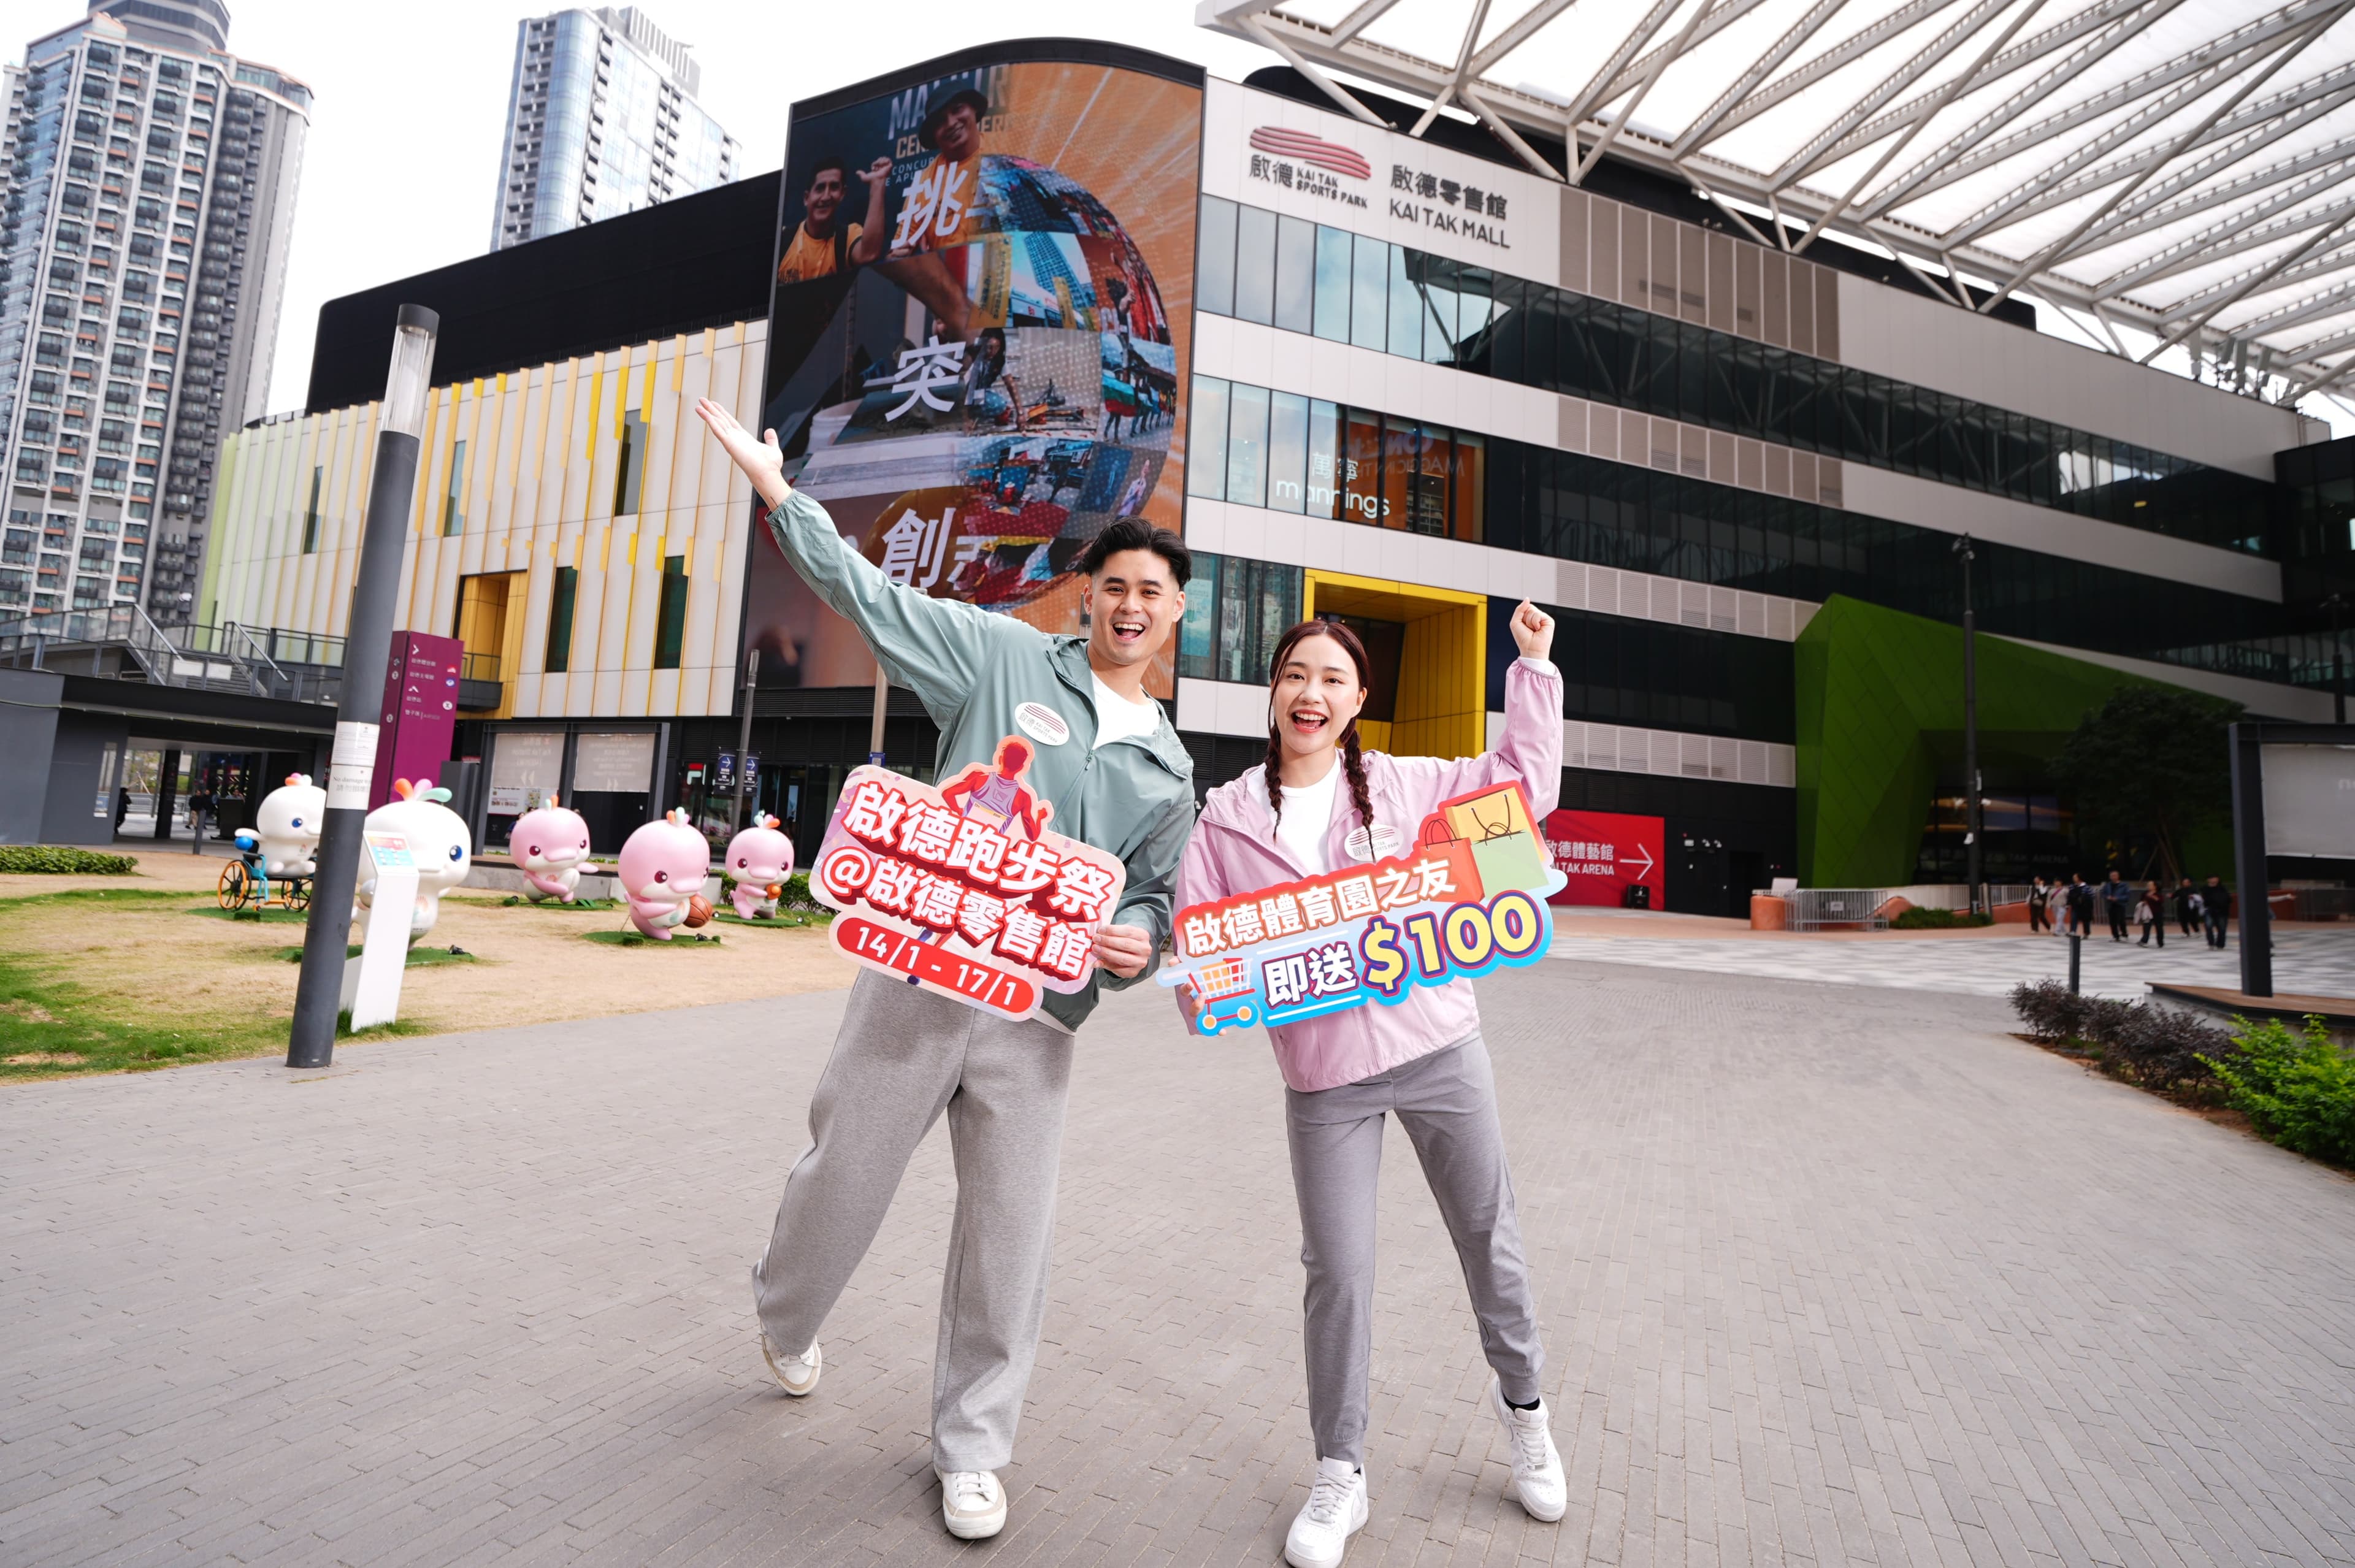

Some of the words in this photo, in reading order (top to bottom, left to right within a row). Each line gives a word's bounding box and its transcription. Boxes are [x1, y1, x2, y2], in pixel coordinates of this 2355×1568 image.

[1249, 155, 1293, 188] 啟德
[1296, 180, 1338, 199] SPORTS
[1341, 192, 1368, 208] PARK
[1297, 167, 1315, 181] KAI
[1319, 173, 1339, 188] TAK
[1391, 164, 1507, 220] 啟德零售館
[1390, 198, 1419, 223] KAI
[1423, 207, 1458, 234] TAK
[1462, 219, 1511, 249] MALL
[1033, 726, 1048, 737] SPORTS
[844, 783, 1112, 920] 啟德跑步祭
[1561, 862, 1580, 874] TAK
[1582, 863, 1614, 876] ARENA
[823, 848, 1092, 977] @啟德零售館
[1184, 858, 1457, 955] 啟德體育園之友
[857, 927, 920, 969] 14/1
[957, 964, 1018, 1006] 17/1
[1264, 944, 1357, 1006] 即送
[1365, 895, 1537, 991] $100
